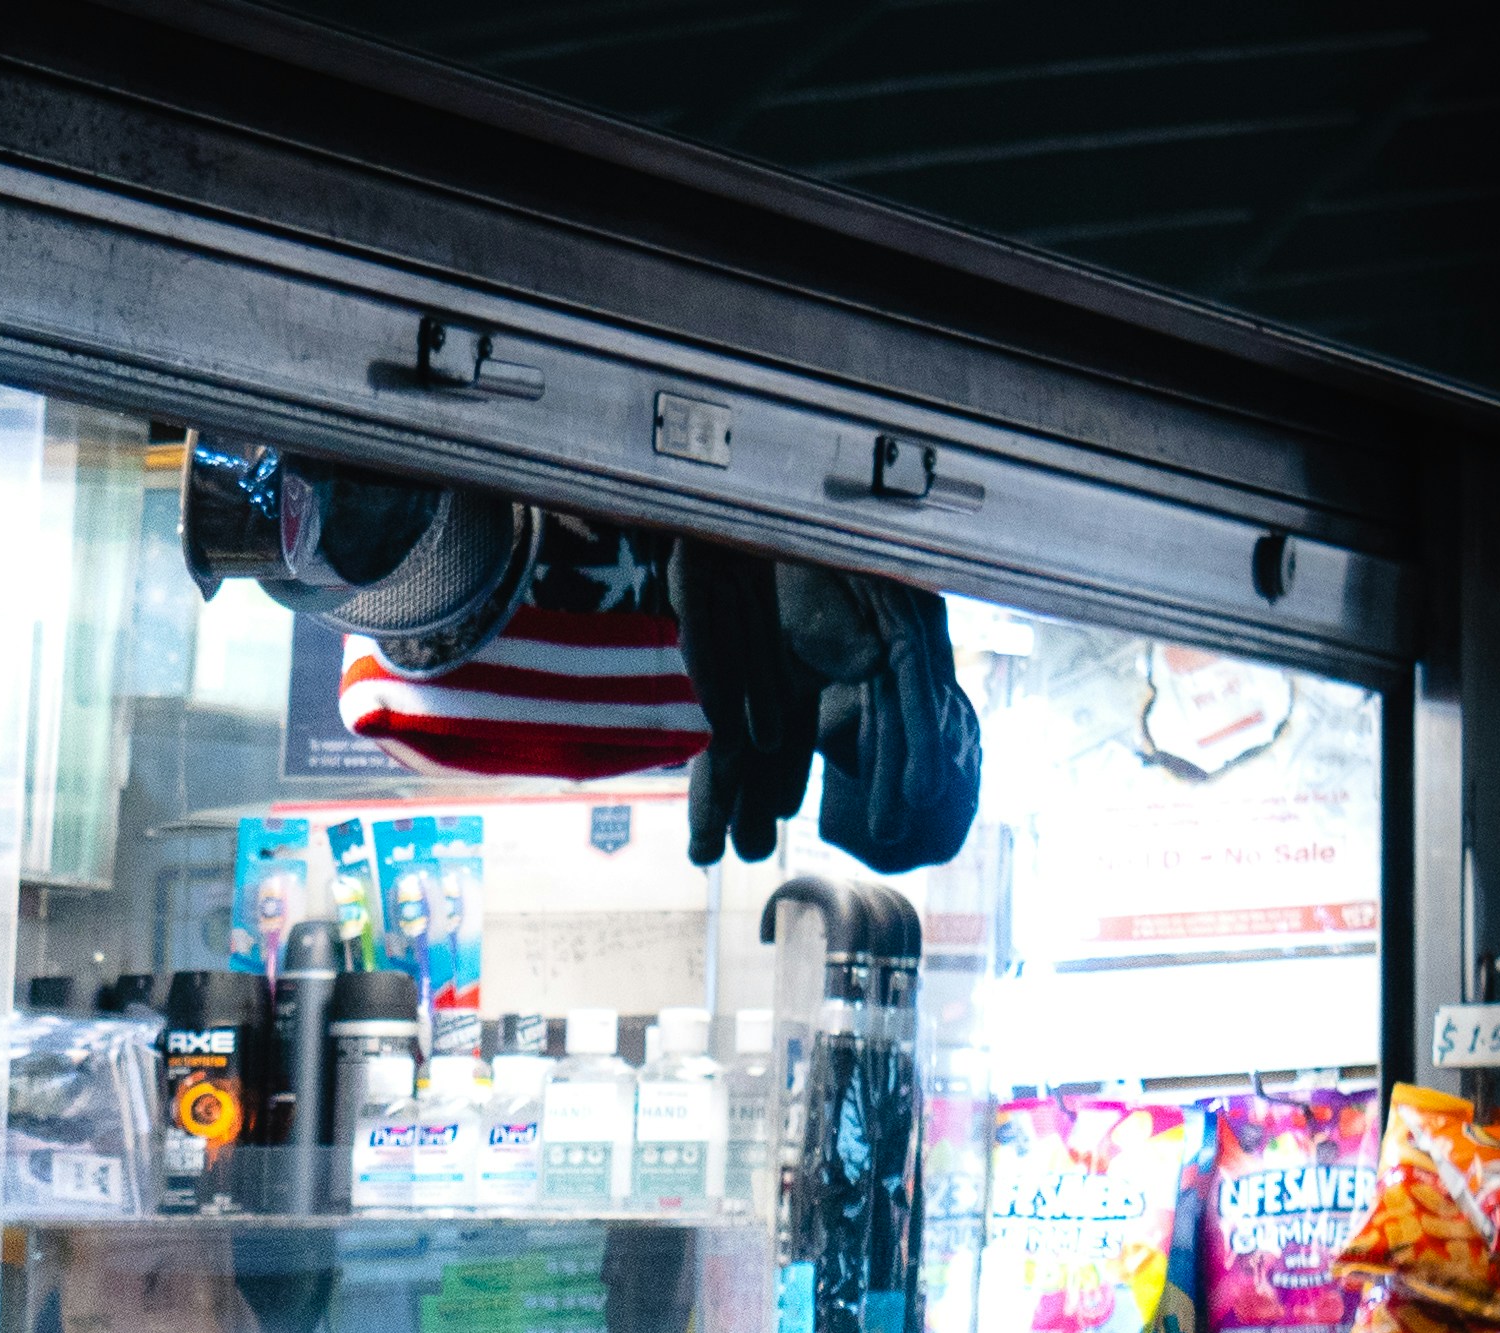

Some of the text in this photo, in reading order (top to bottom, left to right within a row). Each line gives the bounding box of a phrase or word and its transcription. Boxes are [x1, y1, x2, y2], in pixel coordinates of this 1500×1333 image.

[1275, 840, 1337, 865] Sale
[168, 1030, 235, 1054] AXE
[1438, 1017, 1458, 1064] $
[642, 1105, 688, 1120] HAND
[1220, 1164, 1376, 1218] LIFESAVER
[1231, 1213, 1352, 1255] GUMMIE
